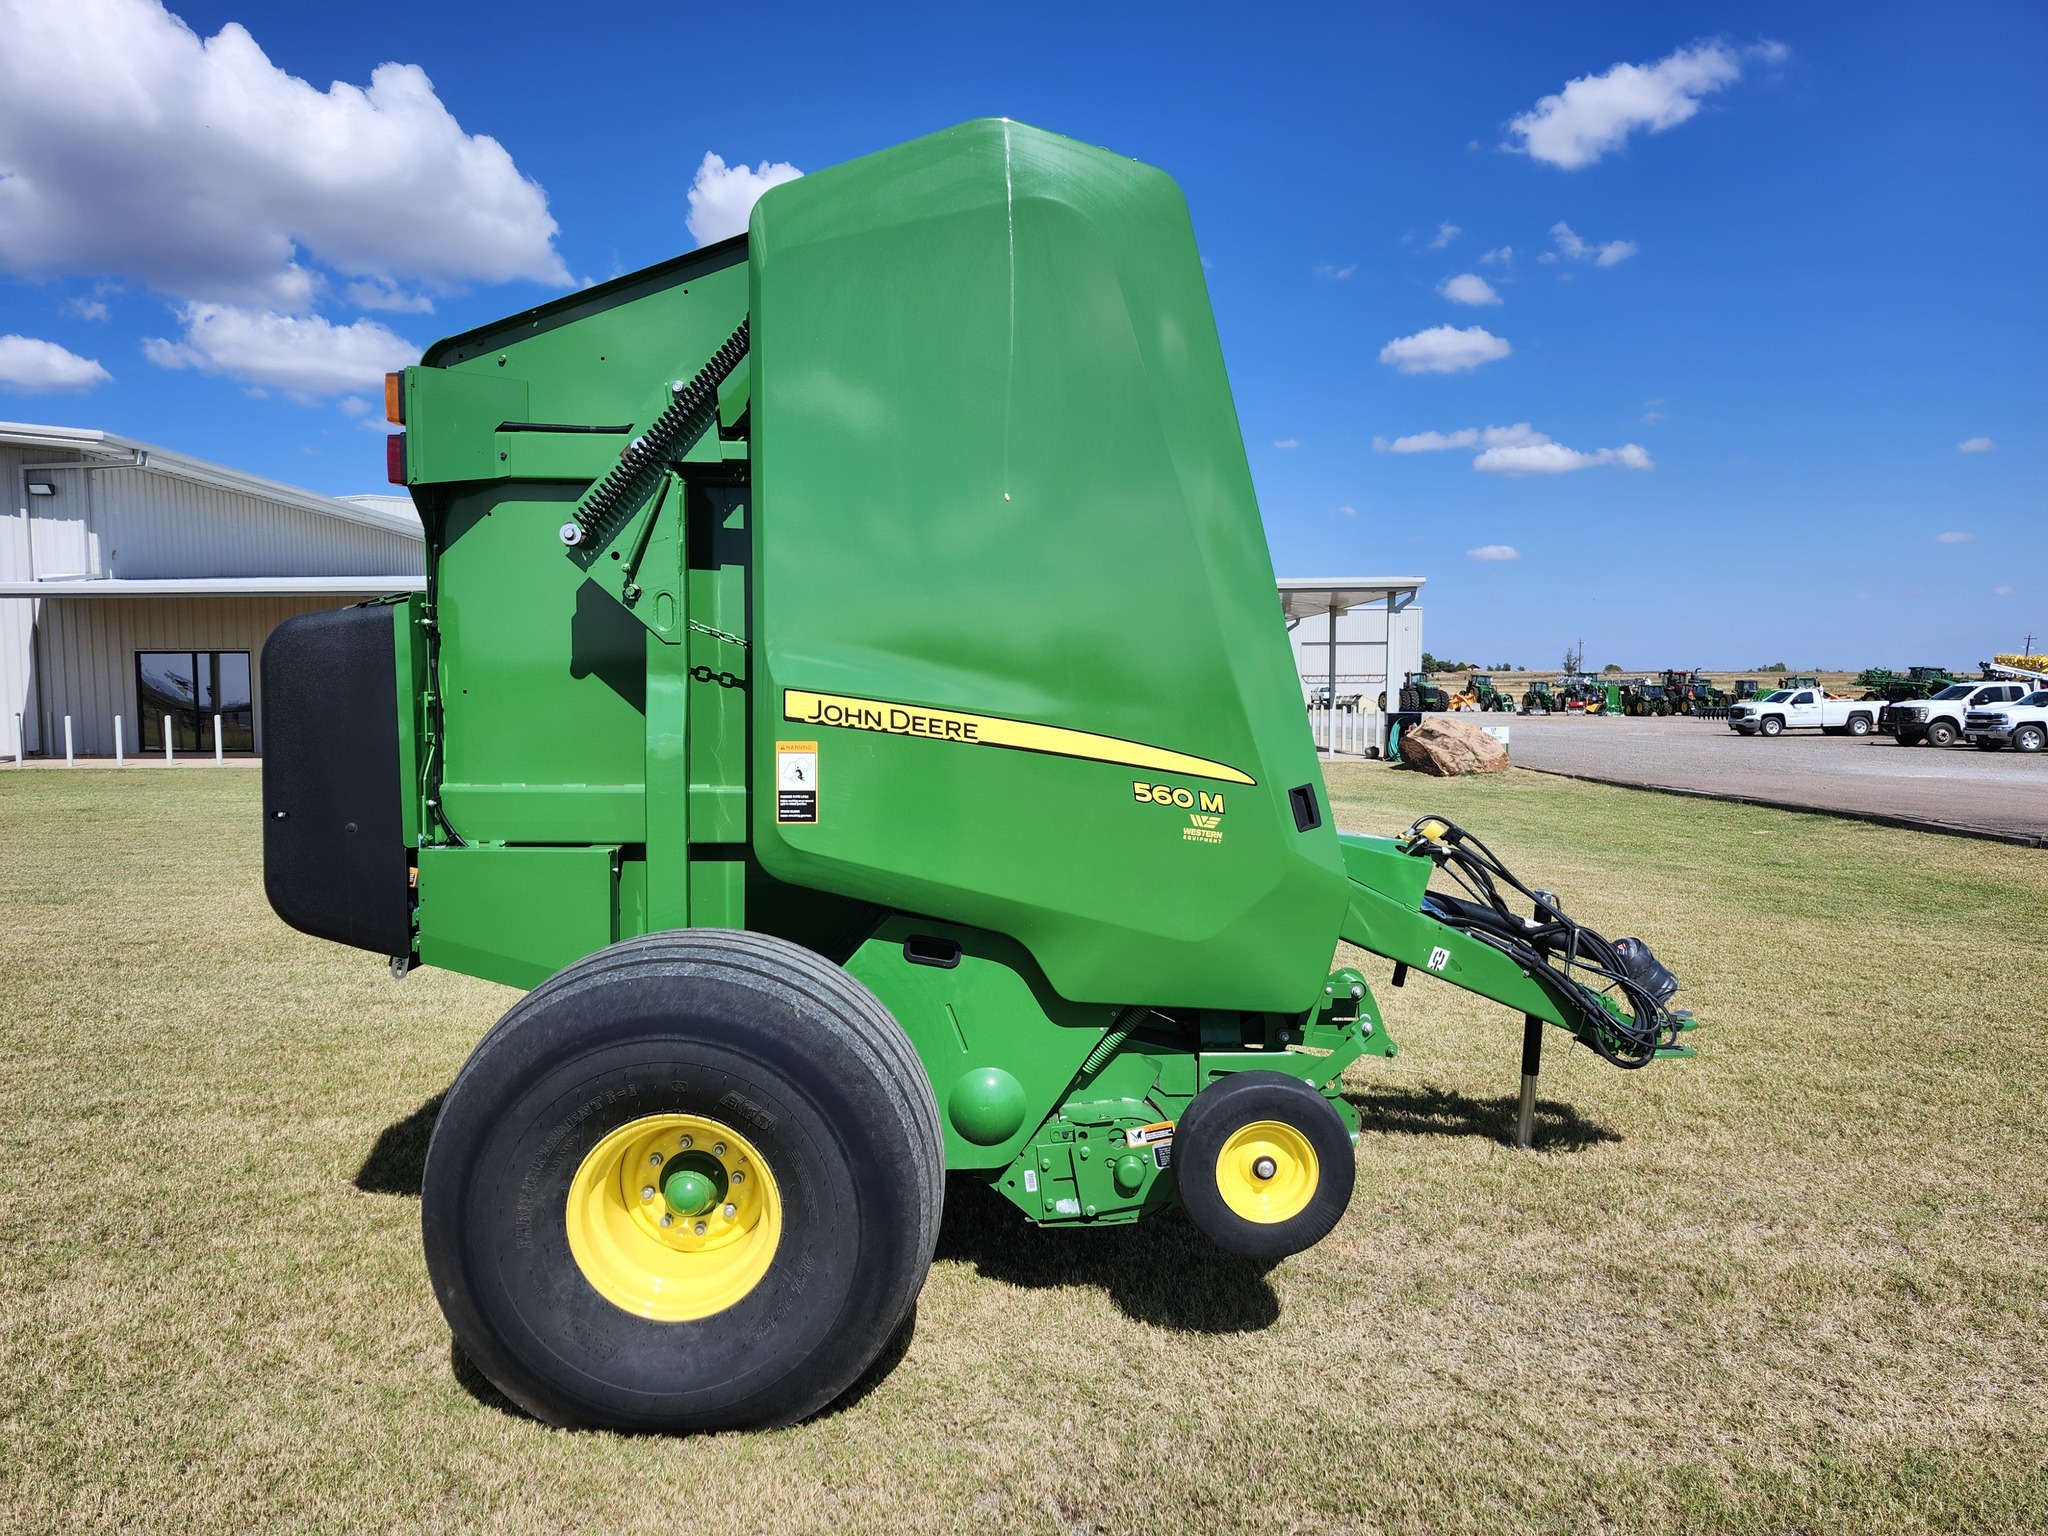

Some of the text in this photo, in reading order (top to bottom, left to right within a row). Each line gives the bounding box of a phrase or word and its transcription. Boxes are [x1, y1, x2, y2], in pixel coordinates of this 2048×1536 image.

[808, 700, 979, 740] JOHN DEERE
[1132, 780, 1226, 815] 560 M
[1182, 835, 1223, 844] EQUIPMENT
[1183, 827, 1223, 839] WESTERN
